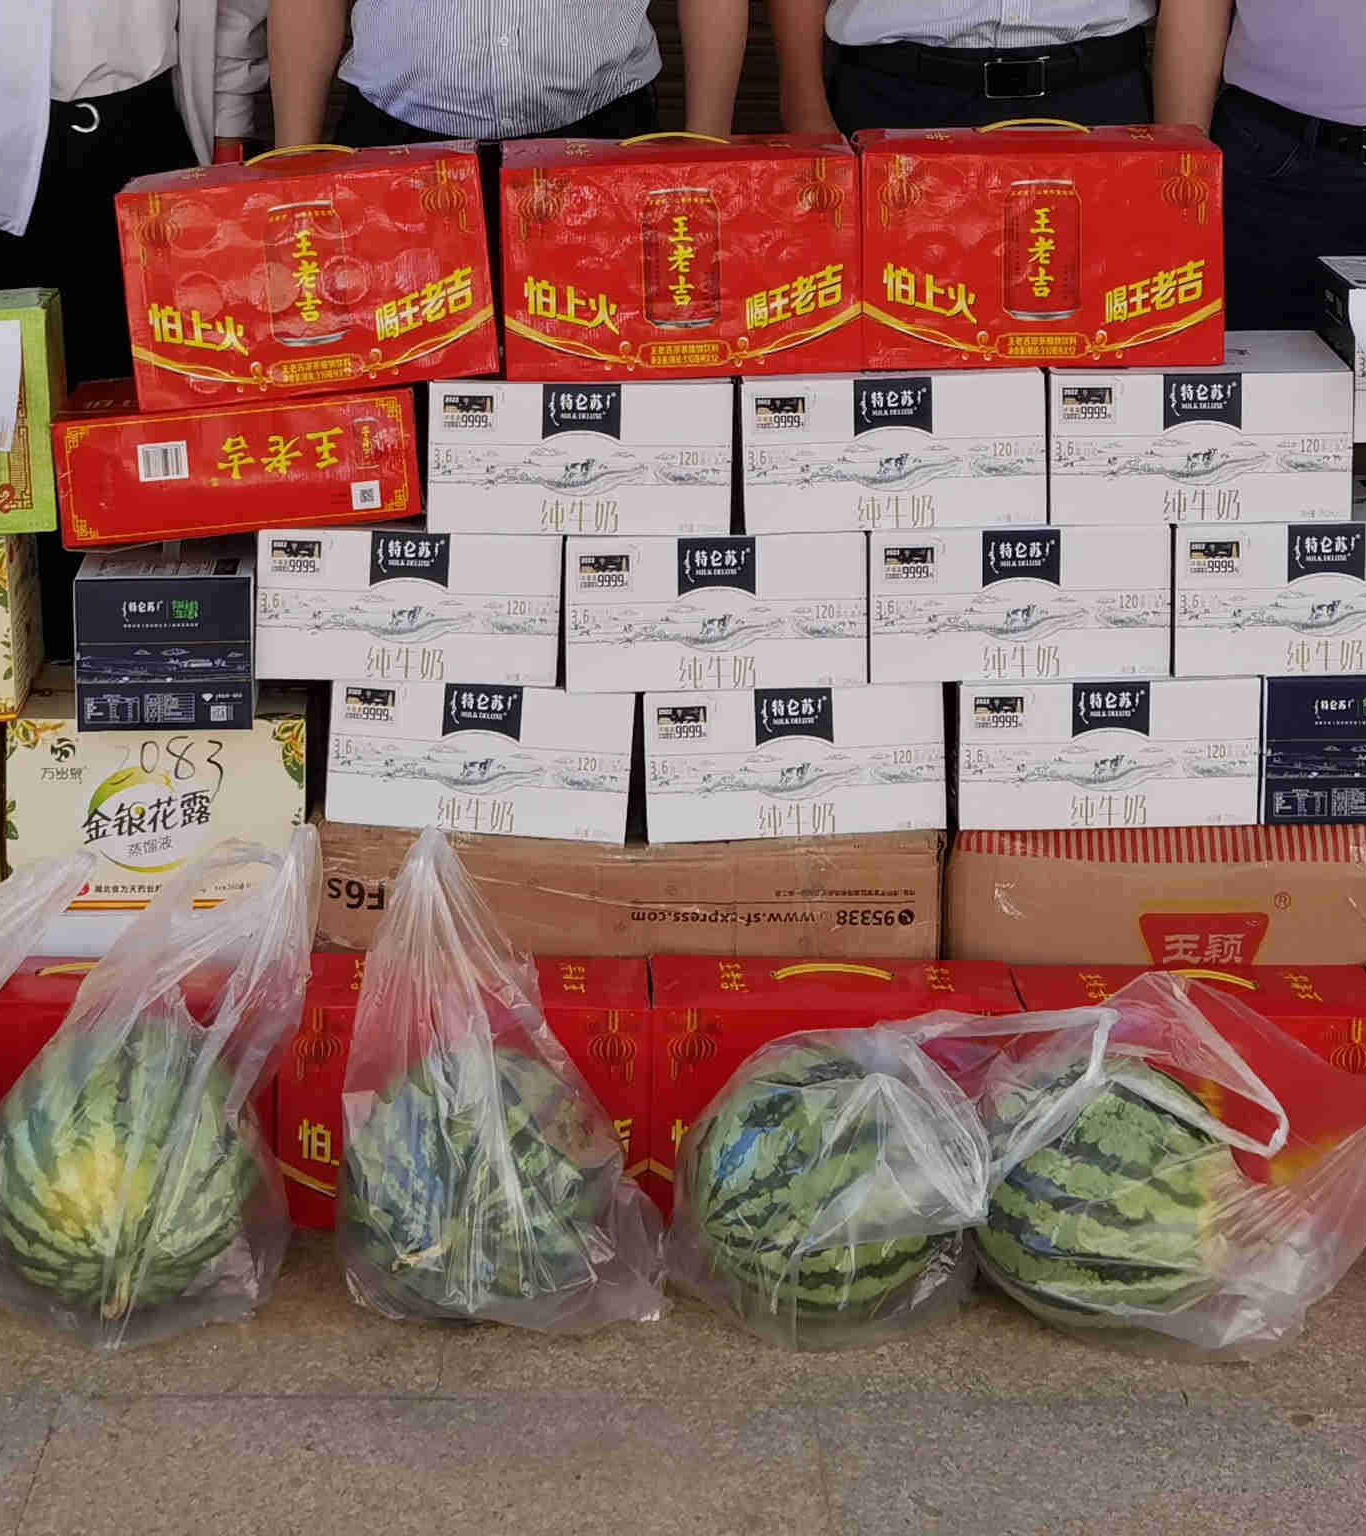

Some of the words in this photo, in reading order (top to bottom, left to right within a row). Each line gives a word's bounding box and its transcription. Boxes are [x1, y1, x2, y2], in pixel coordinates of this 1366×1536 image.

[668, 216, 694, 306] 王老吉
[1028, 208, 1055, 298] 王老吉
[292, 231, 321, 323] 王老吉
[746, 264, 844, 330] 喝王老吉
[883, 263, 977, 325] 怕上火
[1105, 259, 1205, 325] 喝王老吉
[374, 266, 474, 341] 喝王老吉
[524, 276, 620, 335] 怕上火
[148, 302, 249, 356] 怕上火
[559, 393, 603, 413] 特仑苏
[871, 390, 915, 410] 特仑苏
[1181, 384, 1225, 402] 特仑苏
[461, 414, 489, 429] 9999
[773, 414, 801, 429] 9999
[1081, 406, 1109, 420] 9999
[218, 426, 344, 478] 王老吉
[541, 499, 621, 533] 纯牛奶
[857, 493, 937, 529] 纯牛奶
[1163, 488, 1243, 522] 纯牛奶
[389, 540, 433, 560] 特仑苏
[999, 542, 1043, 560] 特仑苏
[1305, 536, 1349, 554] 特仑苏
[288, 558, 316, 575] 9999
[695, 550, 739, 568] 特仑苏
[1207, 560, 1235, 574] 9999
[597, 573, 625, 589] 9999
[903, 565, 931, 581] 9999
[367, 645, 447, 681] 纯牛奶
[983, 644, 1063, 680] 纯牛奶
[1287, 639, 1366, 673] 纯牛奶
[679, 655, 759, 689] 纯牛奶
[461, 692, 505, 714] 特仑苏
[771, 698, 815, 718] 特仑苏
[1090, 691, 1132, 710] 特仑苏
[363, 706, 391, 722] 9999
[991, 714, 1019, 730] 9999
[675, 724, 703, 740] 9999
[82, 789, 211, 845] 金银花露
[437, 795, 517, 833] 纯牛奶
[759, 801, 839, 837] 纯牛奶
[1071, 793, 1149, 826] 纯牛奶
[631, 908, 816, 927] www.sf-express.com
[836, 910, 894, 926] 95338
